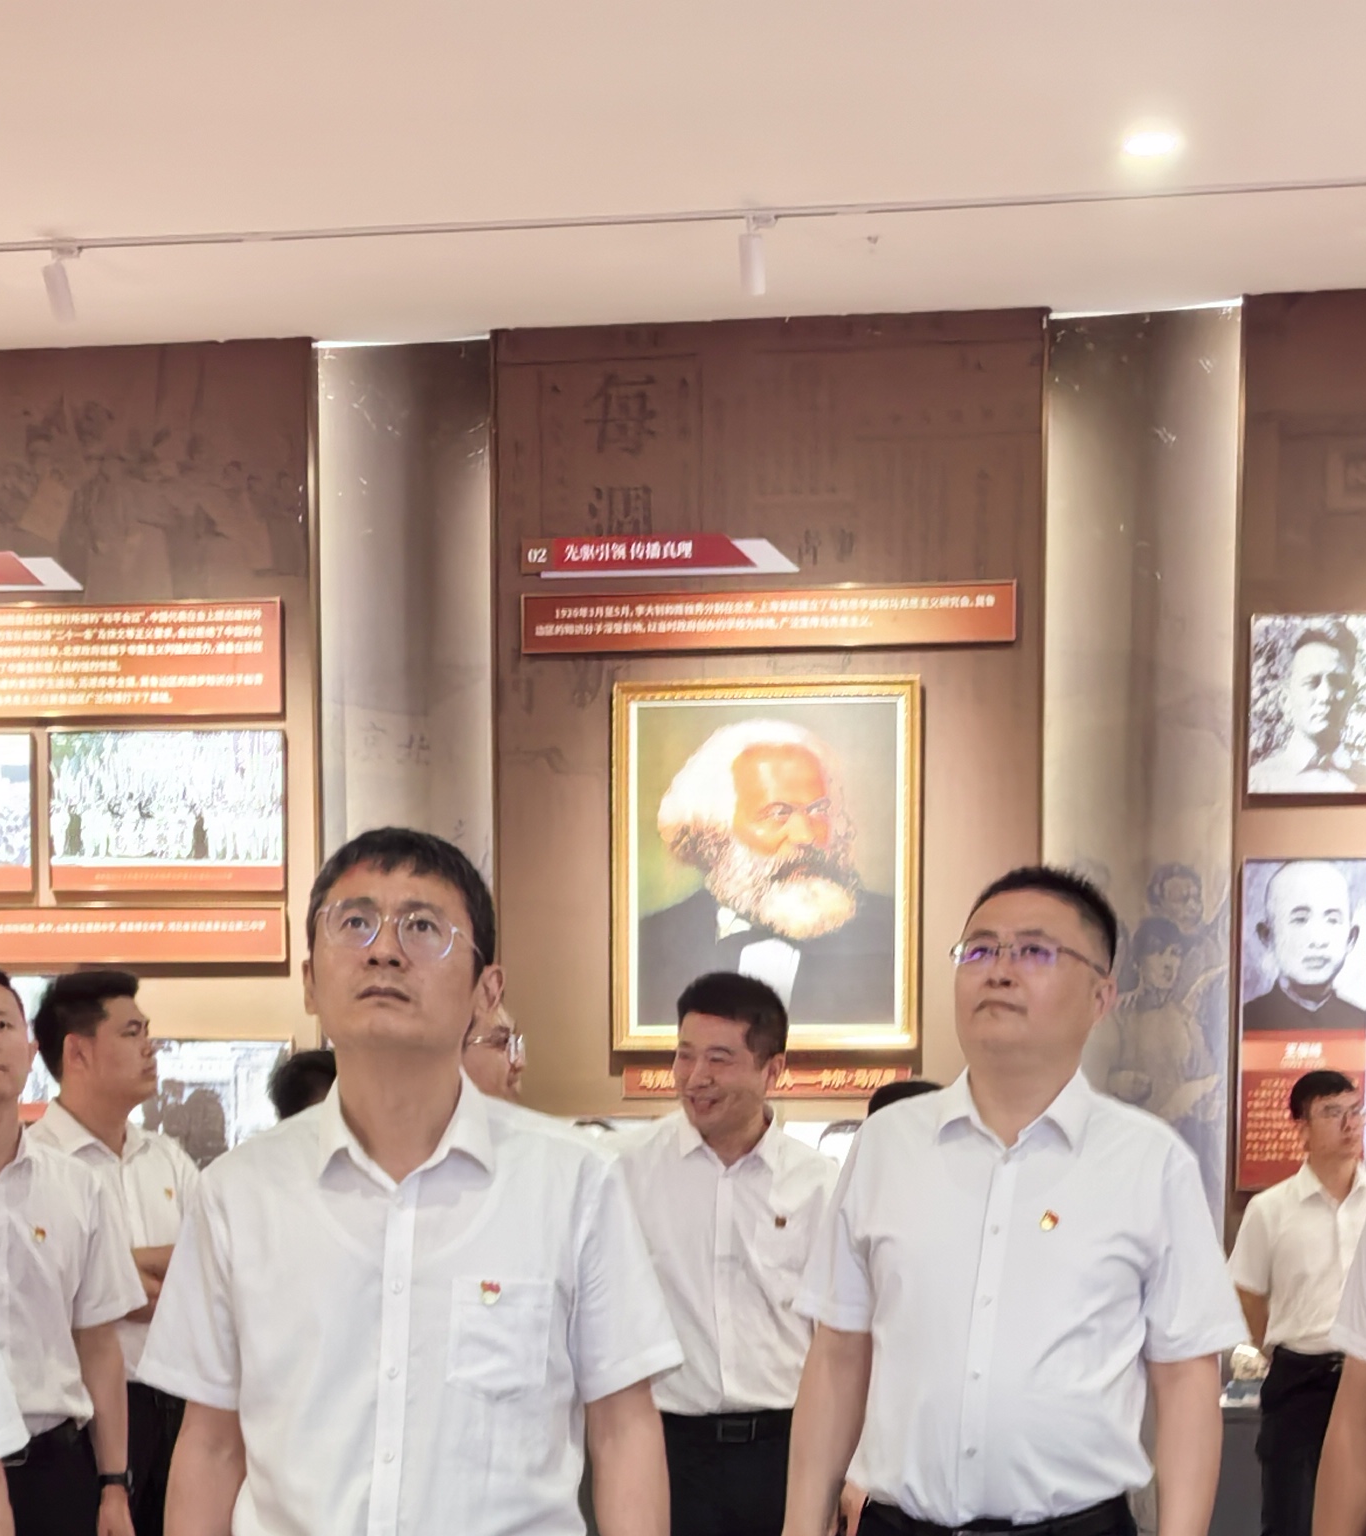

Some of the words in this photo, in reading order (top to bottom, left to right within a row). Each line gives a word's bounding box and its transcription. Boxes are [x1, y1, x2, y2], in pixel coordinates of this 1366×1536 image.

[528, 548, 547, 563] 02
[563, 542, 627, 562] 先驱引领
[630, 540, 693, 560] 传播真理
